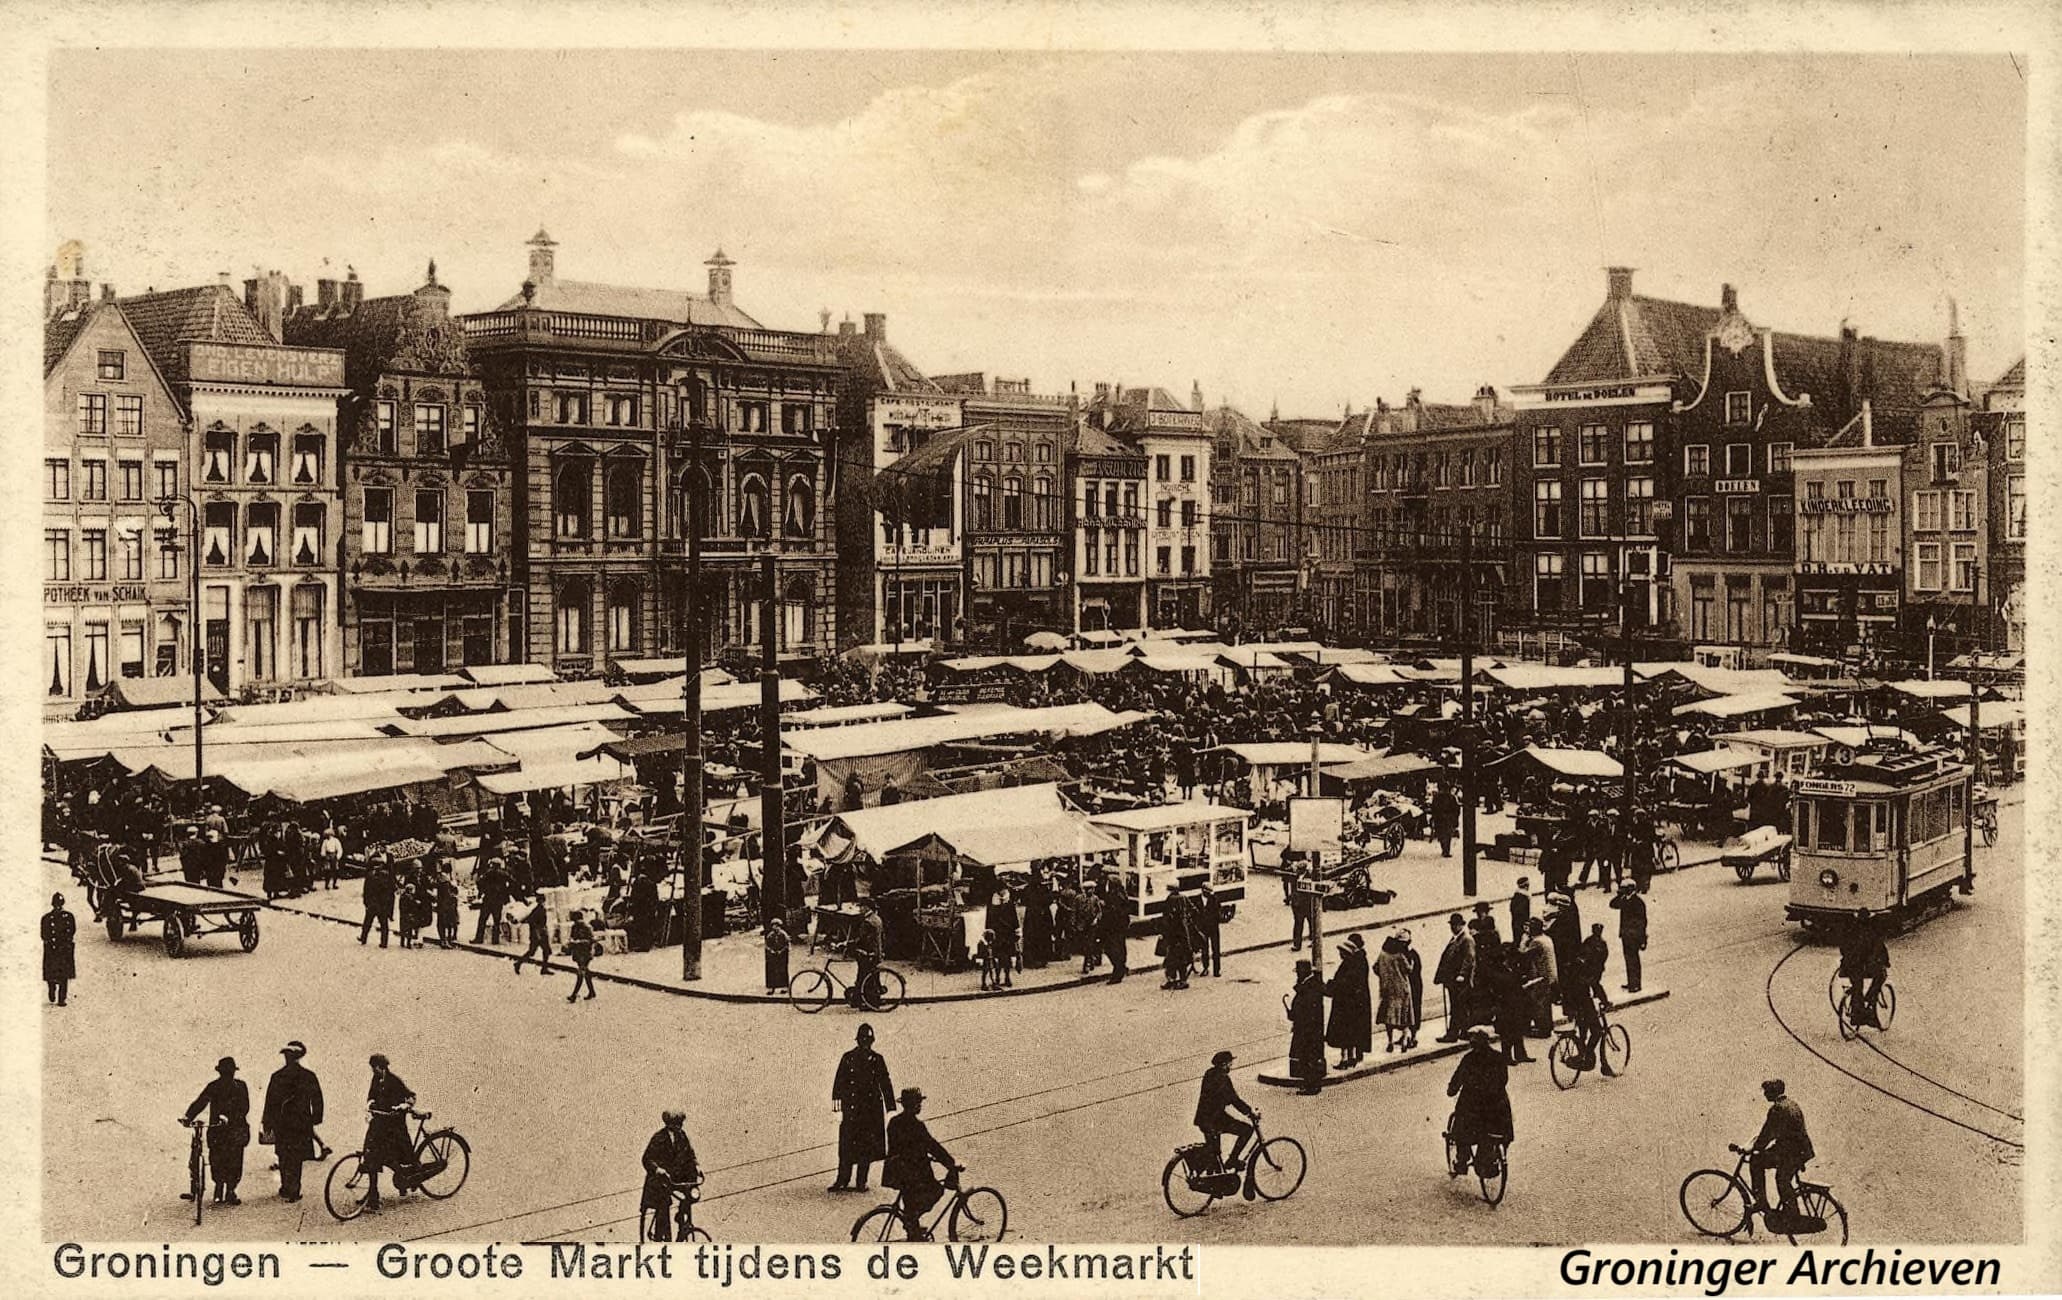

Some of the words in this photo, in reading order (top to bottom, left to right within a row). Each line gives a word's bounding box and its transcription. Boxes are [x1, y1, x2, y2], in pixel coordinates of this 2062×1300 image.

[207, 359, 268, 377] EIGEN
[1545, 391, 1581, 402] HOTEL
[1594, 387, 1636, 399] DOELEN
[1716, 480, 1757, 492] DOELEN
[1800, 498, 1891, 514] KINDERKLEEDING
